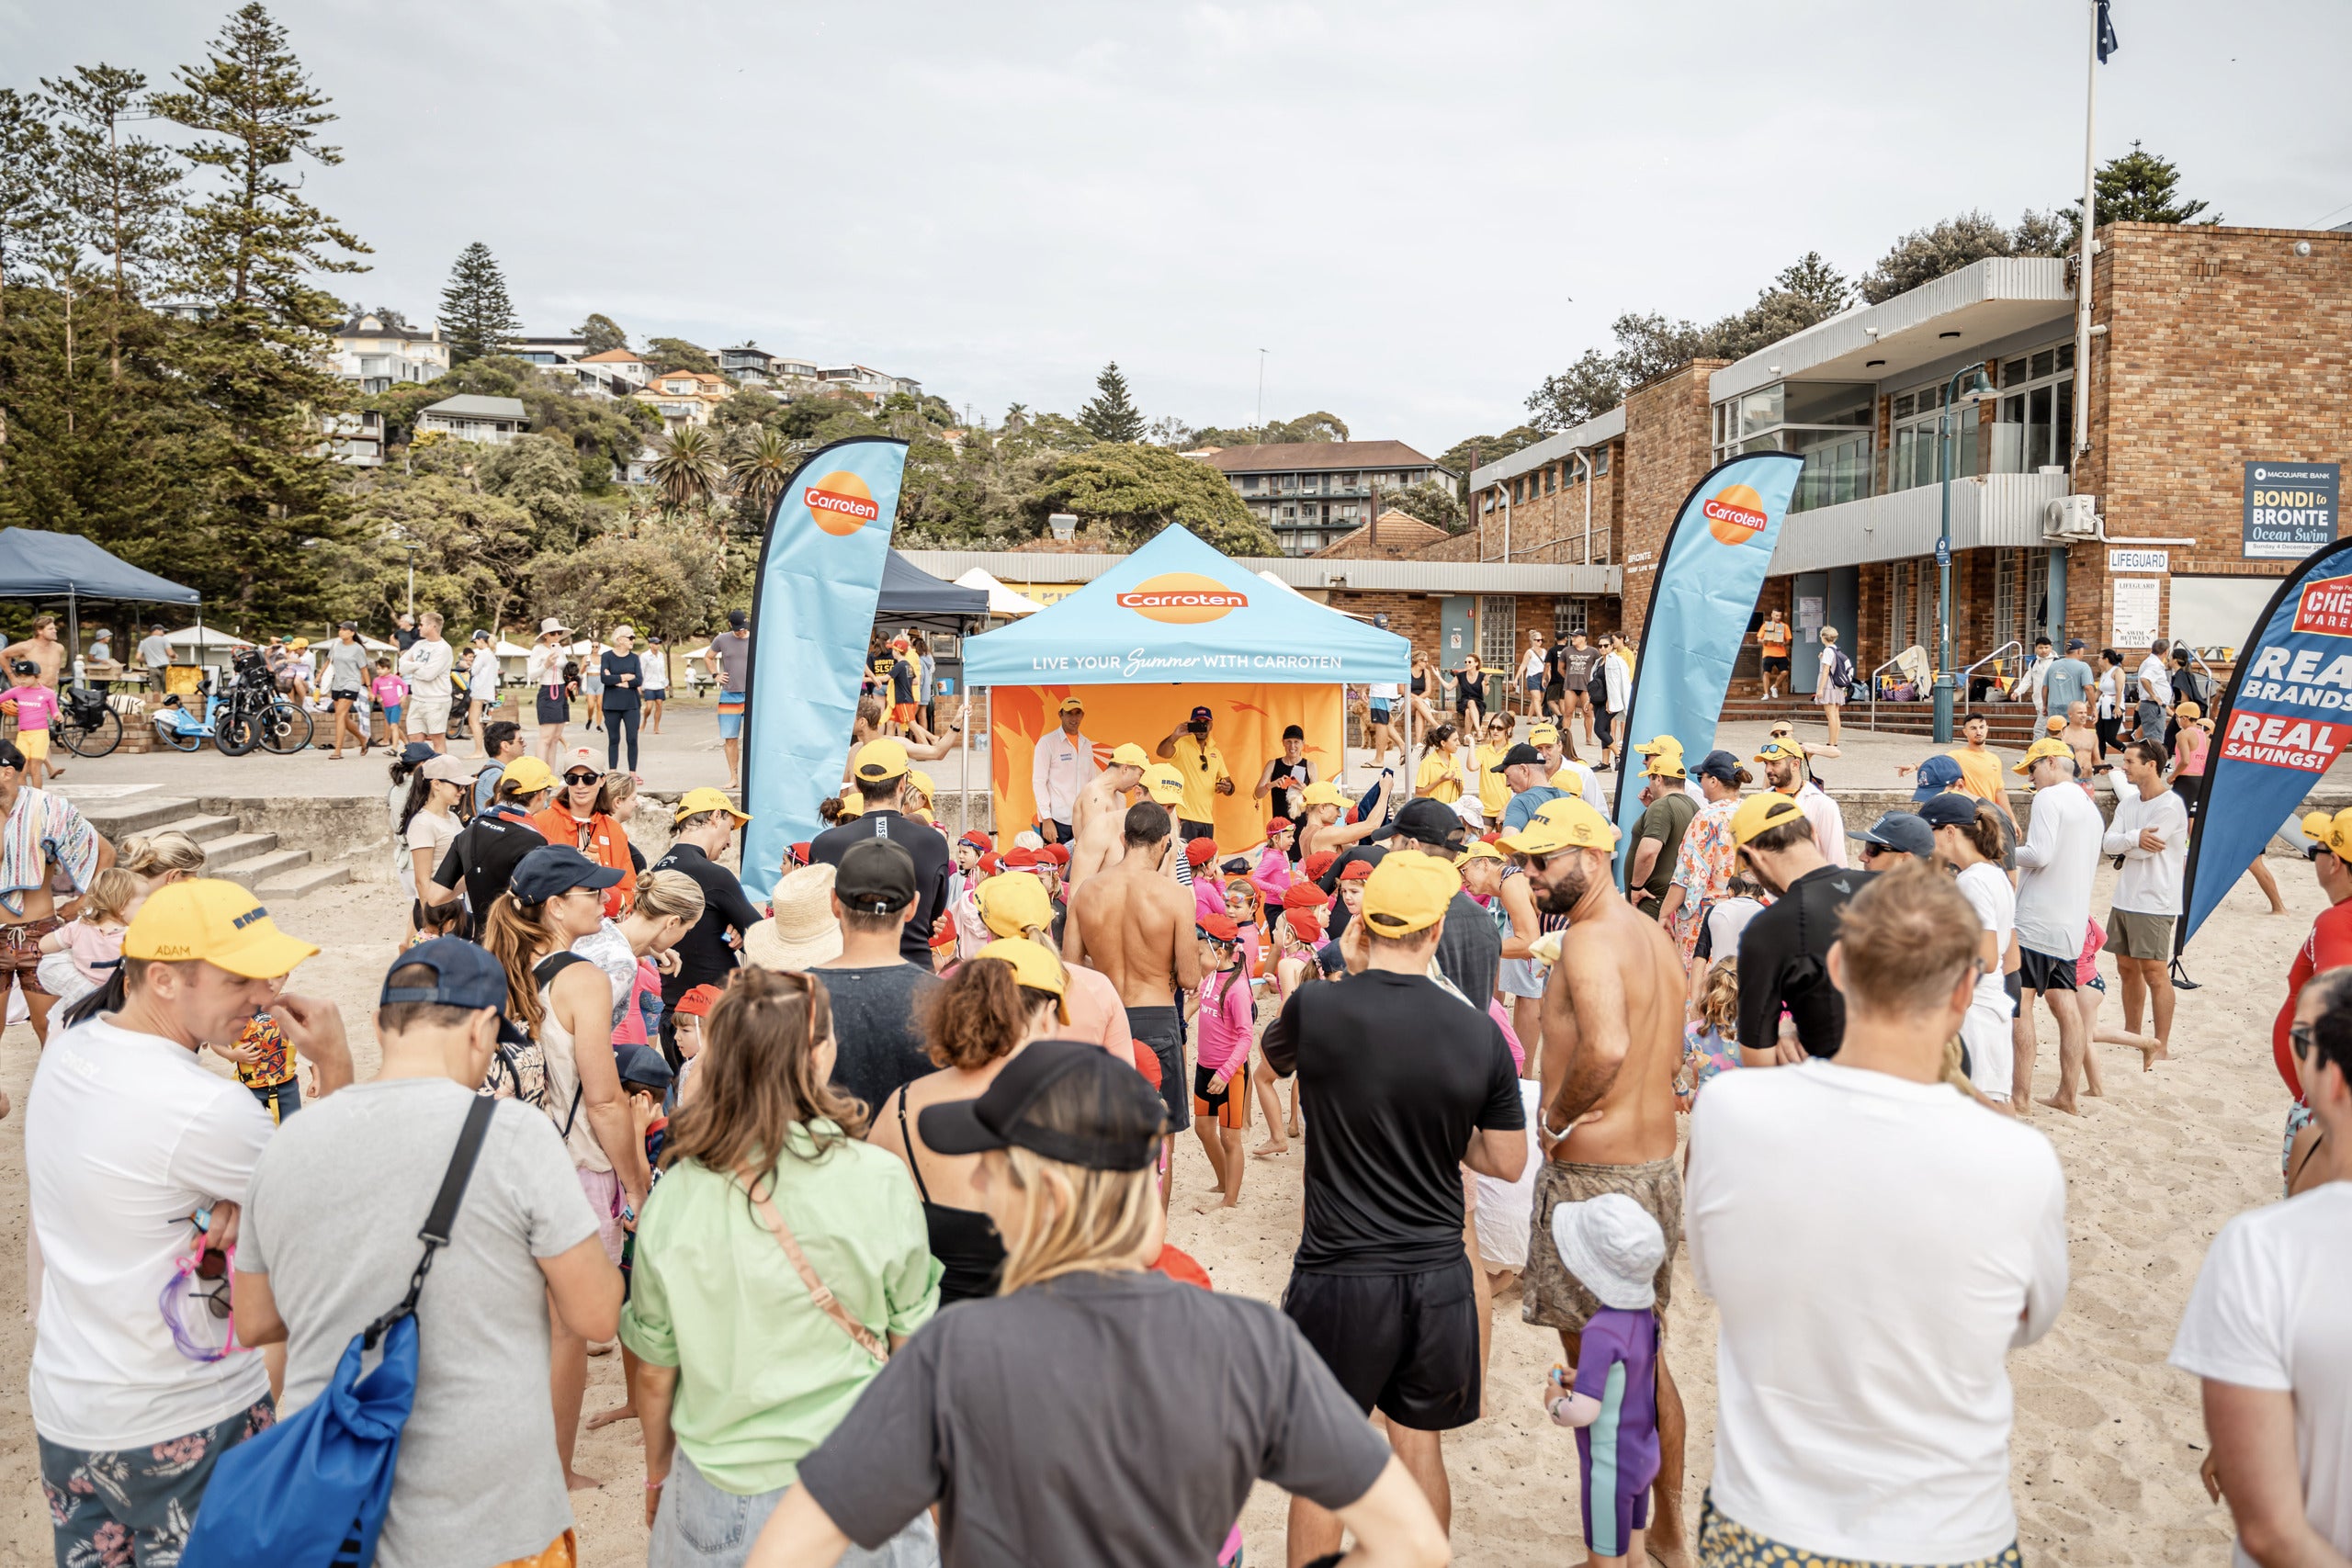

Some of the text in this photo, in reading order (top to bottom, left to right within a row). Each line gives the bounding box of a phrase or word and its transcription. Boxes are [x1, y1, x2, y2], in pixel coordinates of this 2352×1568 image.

[807, 491, 876, 518] Carroten
[2253, 491, 2327, 508] BONDI to
[1706, 502, 1764, 529] Carroten
[2253, 508, 2329, 526] BRONTE
[2253, 526, 2328, 543] Ocean Swim
[1628, 551, 1652, 563] BRONTE
[2111, 553, 2165, 568] LIFEGUARD
[1122, 593, 1243, 606] Carroten
[1033, 647, 1341, 678] LIVE YOUR Summer WITH CARROTEN
[2241, 680, 2352, 711] BRANDS
[2228, 714, 2335, 753] REAL
[2224, 742, 2325, 770] SAVINGS!
[154, 944, 191, 956] ADAM
